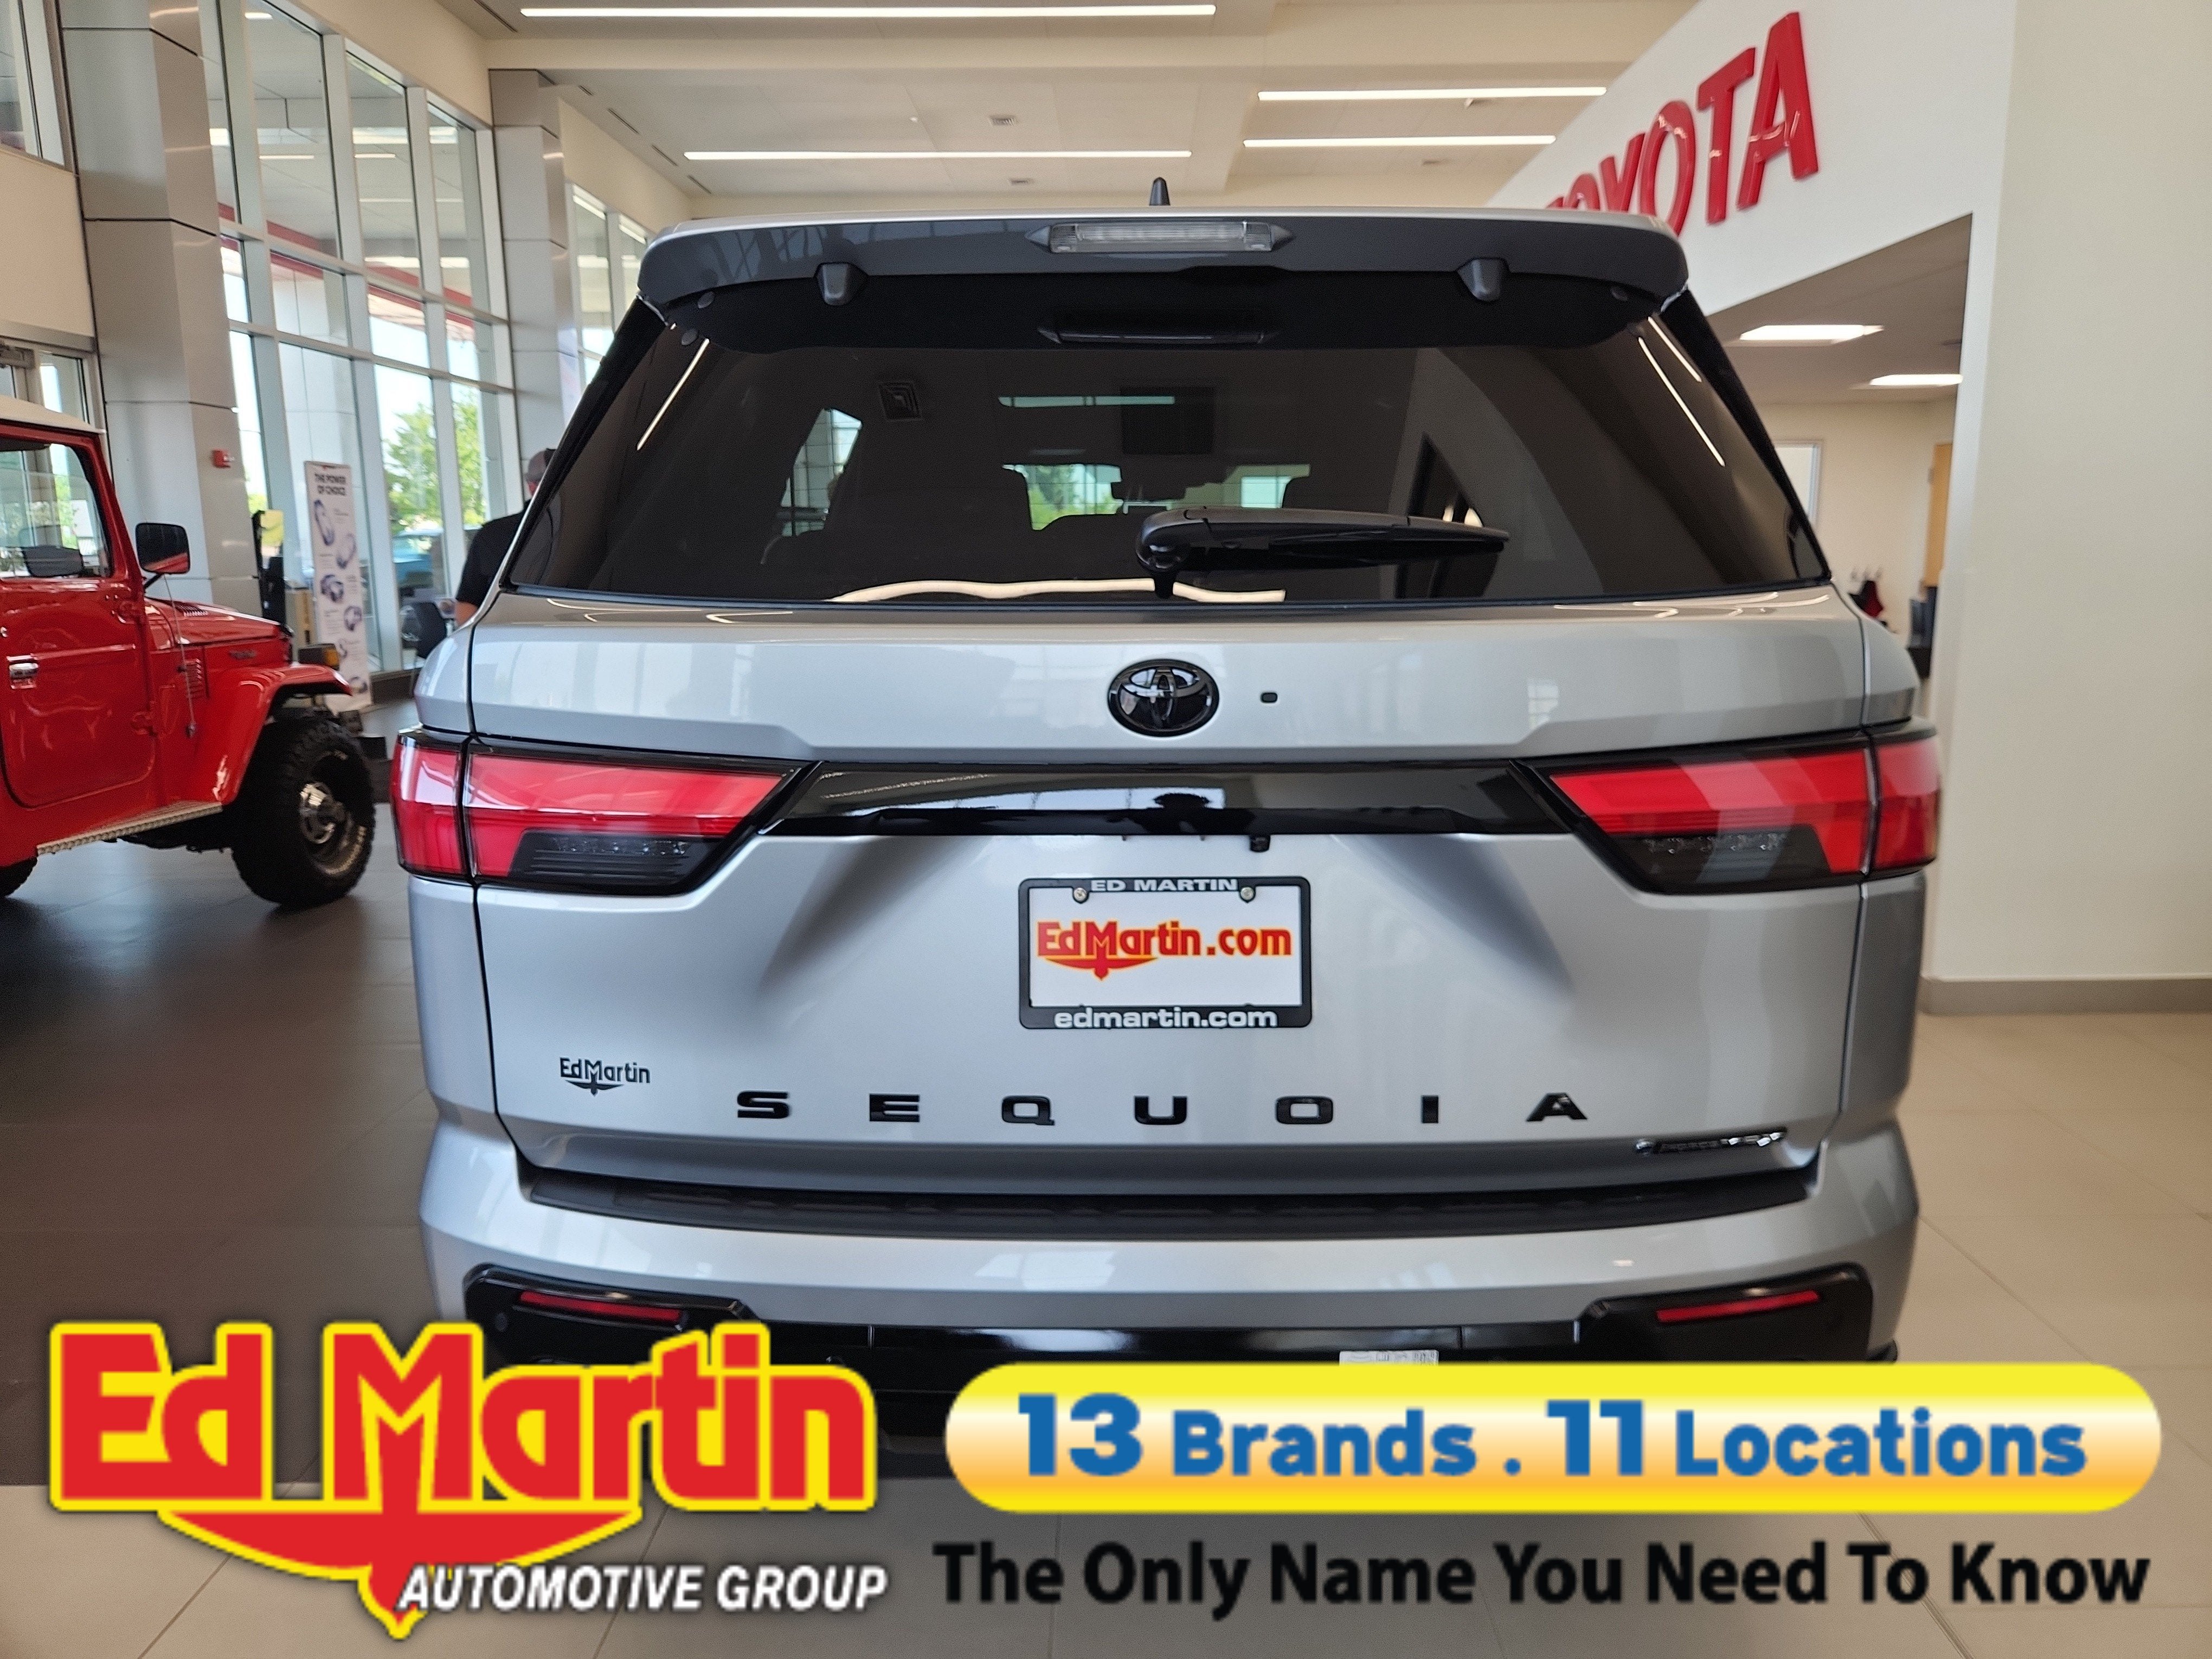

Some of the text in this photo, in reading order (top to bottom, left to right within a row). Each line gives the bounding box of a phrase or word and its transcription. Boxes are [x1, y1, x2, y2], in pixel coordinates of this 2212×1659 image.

[1091, 879, 1237, 891] ED MARTIN
[1054, 1007, 1277, 1028] edmartin.com
[737, 1092, 1587, 1126] SEQUOIA
